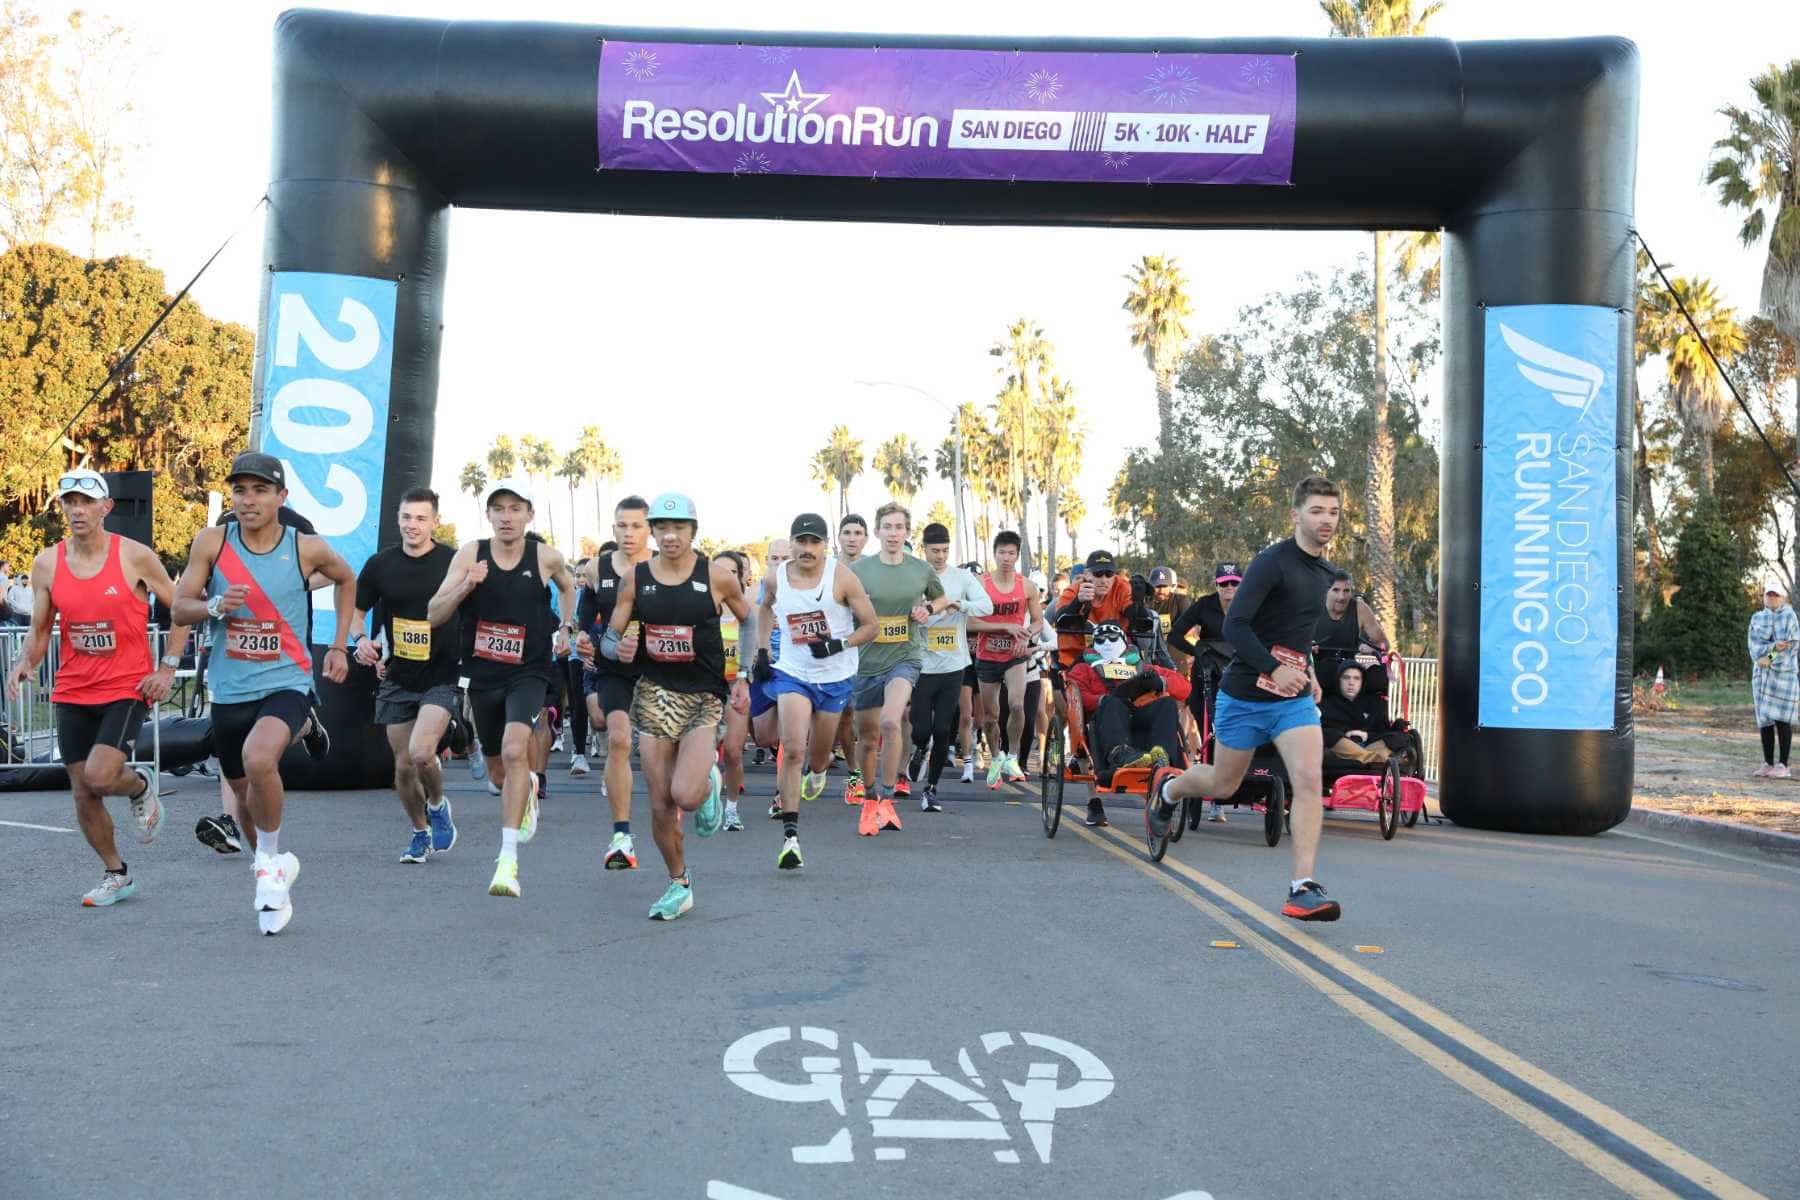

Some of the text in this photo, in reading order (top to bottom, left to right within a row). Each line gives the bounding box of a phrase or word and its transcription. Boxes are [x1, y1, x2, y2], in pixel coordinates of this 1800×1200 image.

[622, 99, 939, 147] ResolutionRun
[960, 119, 1062, 140] SAN DIEGO
[1114, 123, 1258, 144] 5K 10K HALF
[271, 293, 381, 611] 202
[1554, 431, 1592, 645] SAN DIEGO
[1511, 432, 1552, 713] RUNNING CO.
[801, 620, 828, 635] 2418
[884, 625, 907, 637] 1398
[82, 634, 113, 648] 2101
[239, 634, 279, 651] 2348
[402, 631, 429, 645] 1386
[487, 636, 521, 654] 2344
[658, 639, 690, 653] 2316
[936, 635, 954, 646] 1421
